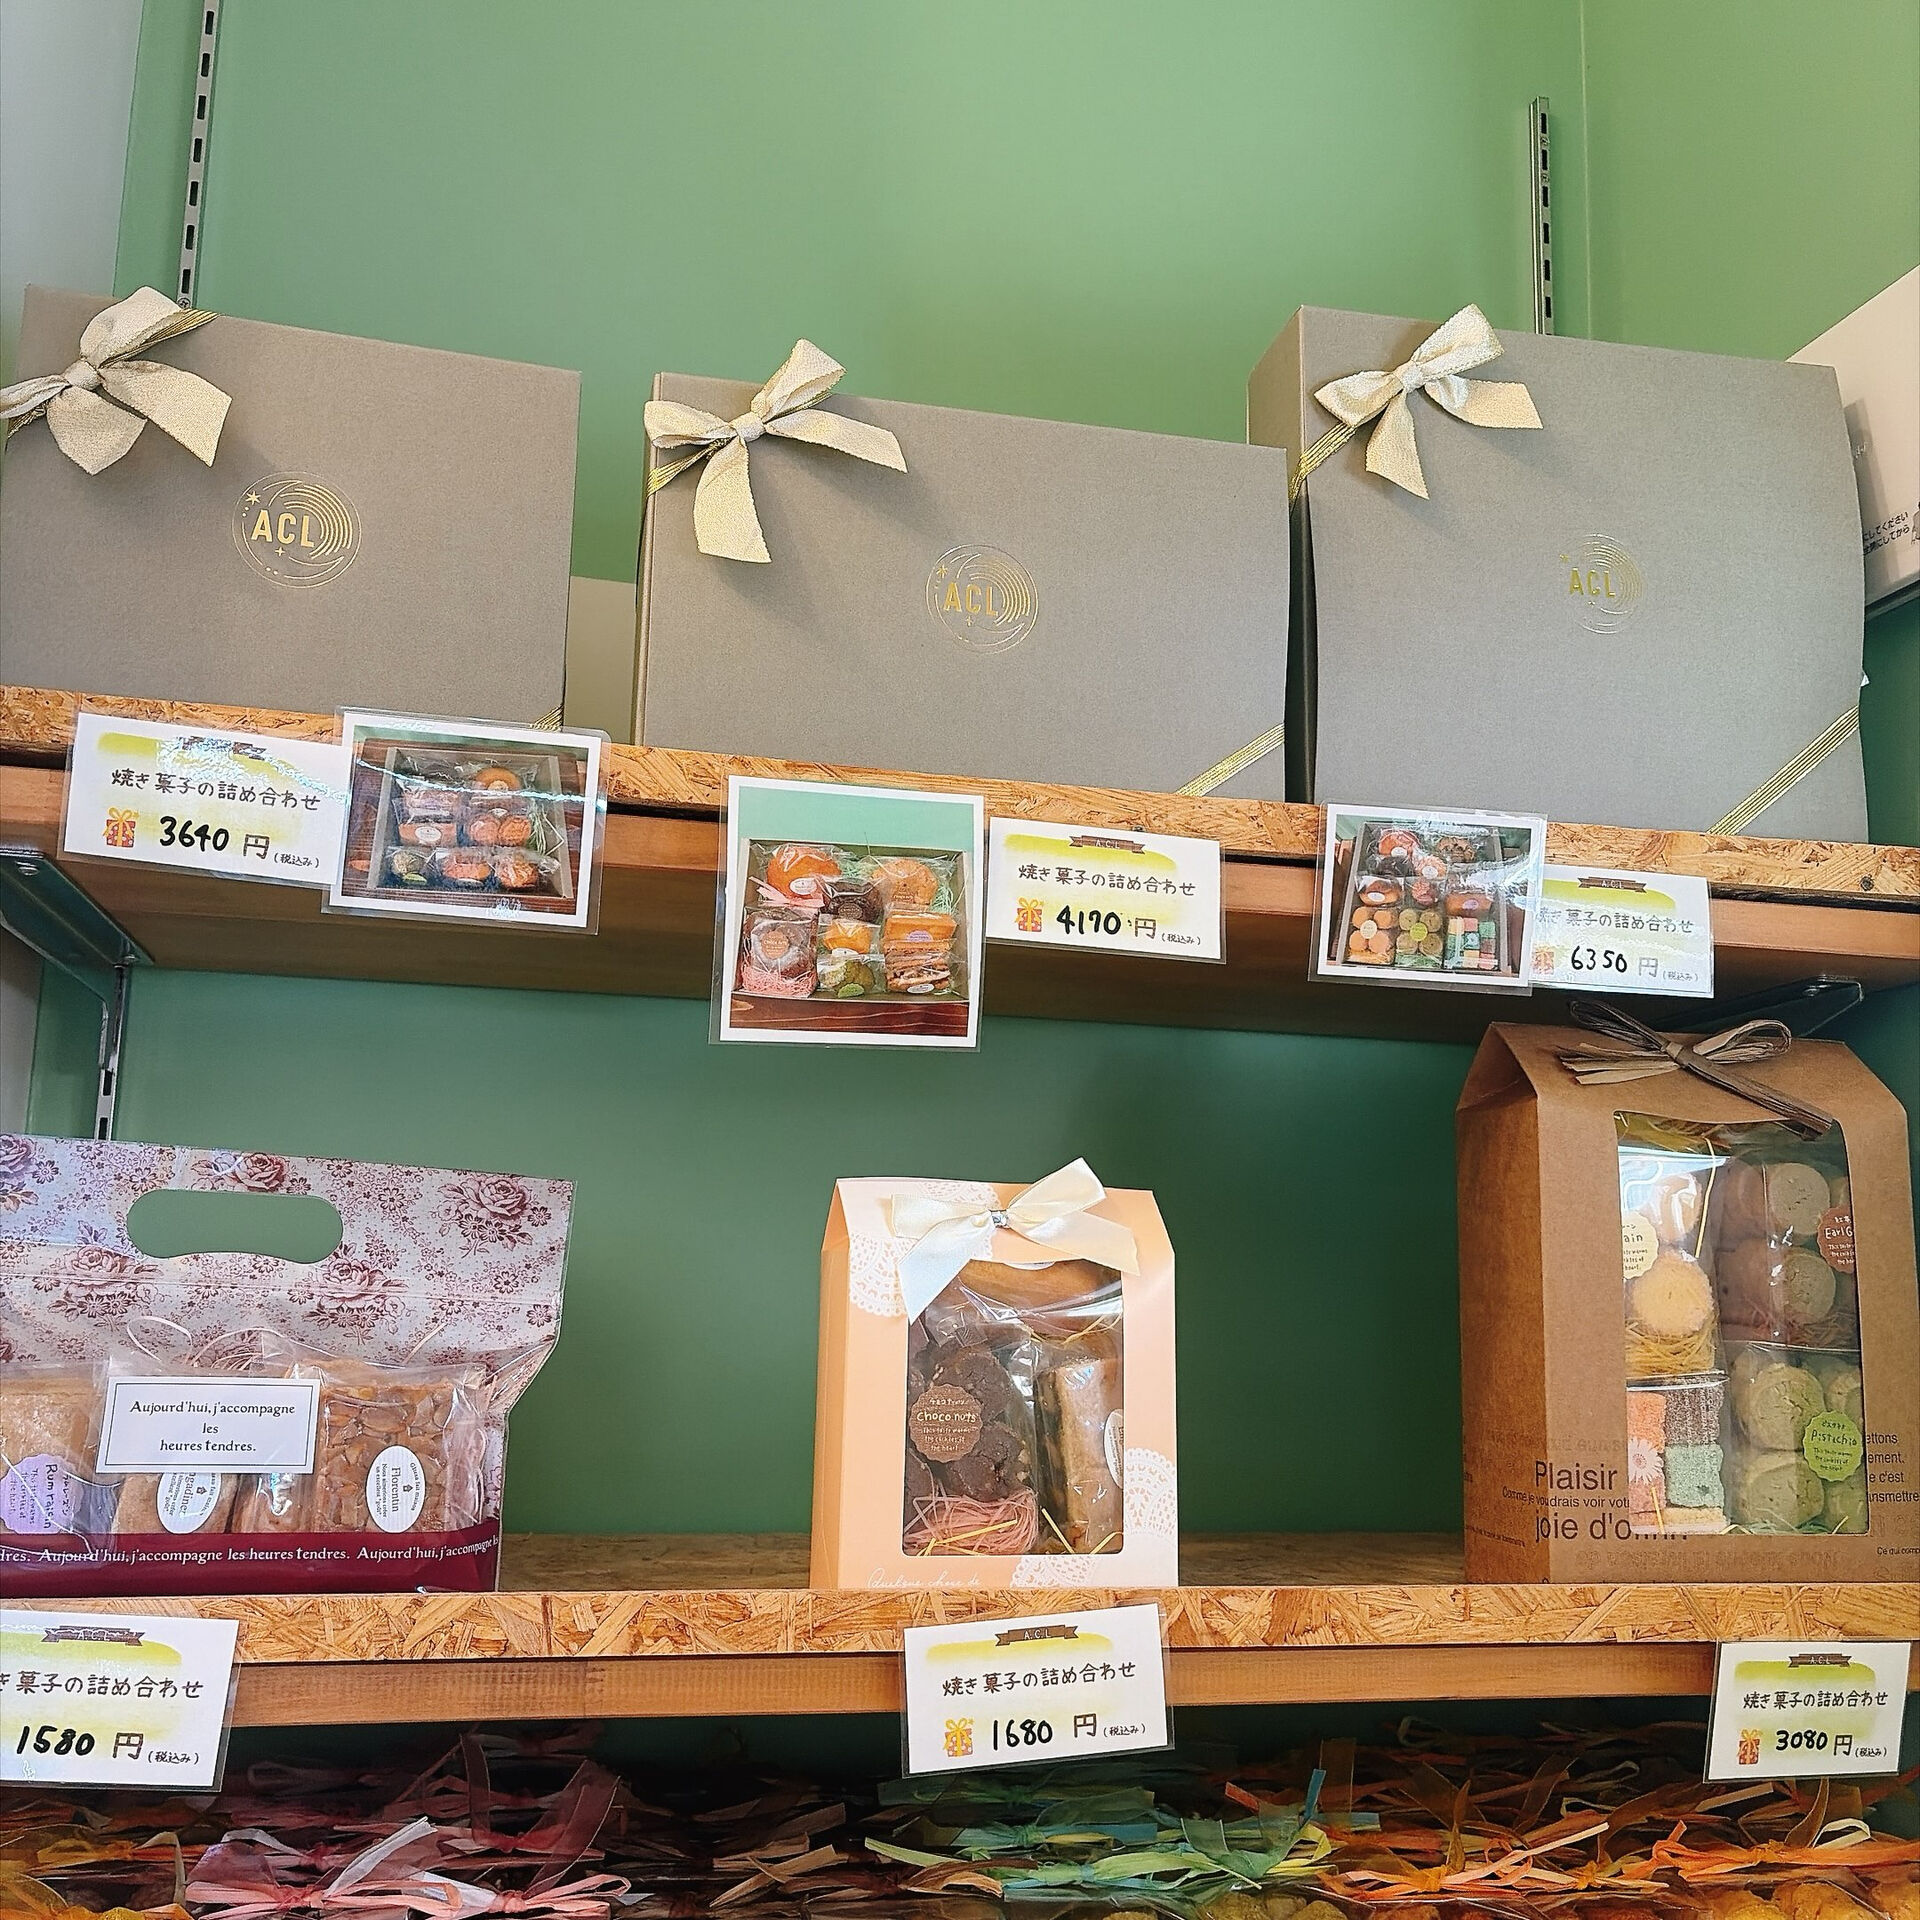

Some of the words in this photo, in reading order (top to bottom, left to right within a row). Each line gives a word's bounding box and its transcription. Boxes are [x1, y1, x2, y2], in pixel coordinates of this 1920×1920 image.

[251, 509, 315, 548] ACL
[1569, 566, 1616, 598] ACL
[943, 581, 998, 617] ACL
[111, 767, 321, 811] 焼き菓子の詰め合わせ
[159, 815, 230, 852] 3640
[242, 834, 270, 860] 円
[1018, 863, 1196, 896] 焼き菓子の詰め合わせ
[1056, 905, 1122, 935] 4170
[1134, 917, 1157, 940] 円
[1571, 946, 1628, 973] 6350
[1638, 957, 1659, 978] 円
[1825, 1227, 1845, 1239] Earl
[130, 1401, 211, 1416] Aujourd'hui,
[212, 1401, 295, 1417] j'accompagne
[917, 1410, 951, 1422] Choco
[954, 1411, 976, 1423] nuts
[202, 1423, 219, 1434] les
[160, 1439, 202, 1452] heures
[205, 1440, 256, 1452] tendres.
[46, 1464, 58, 1490] Rum
[391, 1467, 401, 1512] Florentin
[1535, 1460, 1618, 1490] Plaisir
[1879, 1471, 1905, 1483] c'est
[1535, 1495, 1580, 1508] voudrais
[1583, 1497, 1605, 1508] voir
[1870, 1491, 1920, 1503] nsmettre
[1535, 1510, 1578, 1543] joie
[38, 1549, 130, 1564] Aujourd'hui,
[130, 1548, 222, 1565] j'accompagne
[227, 1548, 245, 1560] les
[249, 1548, 293, 1560] heures
[296, 1547, 350, 1560] tendres.
[357, 1547, 438, 1563] Aujourd'hui,
[1877, 1547, 1888, 1555] Ce
[942, 1662, 1136, 1697] 焼き菓子の詰め合わせ
[1743, 1690, 1888, 1710] 焼き菓子の詰め合わせ
[16, 1725, 95, 1756] 1580
[112, 1732, 144, 1760] 円
[993, 1719, 1052, 1751] 1680
[1073, 1713, 1097, 1738] 円
[1776, 1730, 1828, 1751] 3080
[1834, 1734, 1853, 1757] 円
